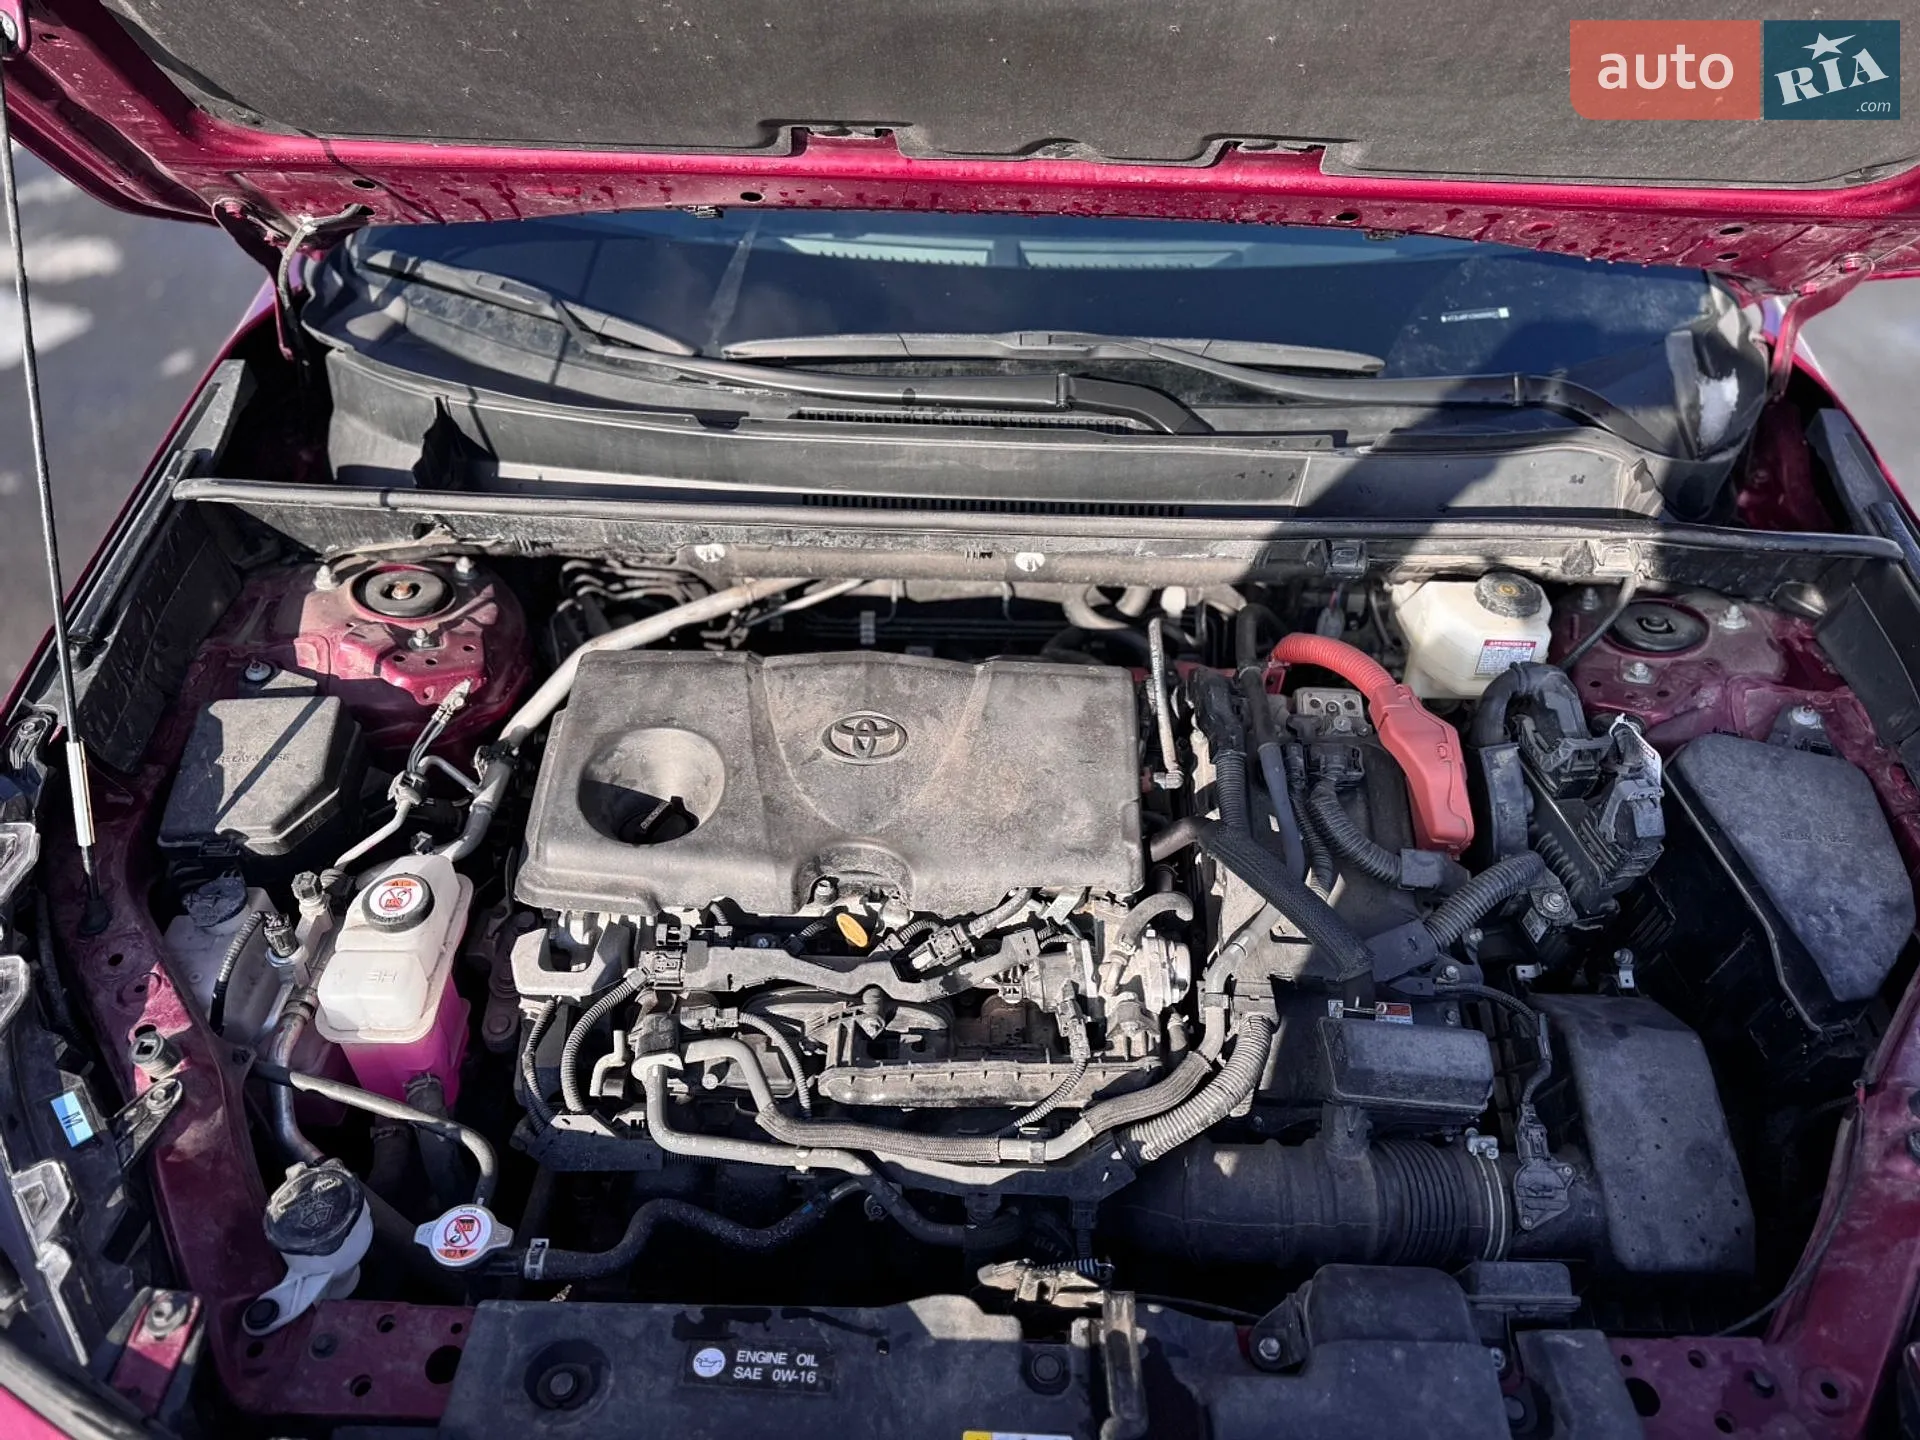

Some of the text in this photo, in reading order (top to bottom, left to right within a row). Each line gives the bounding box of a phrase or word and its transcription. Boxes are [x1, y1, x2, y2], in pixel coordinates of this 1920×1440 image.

[735, 1350, 820, 1368] ENGINE OIL
[732, 1366, 817, 1384] SAE 0W-16
